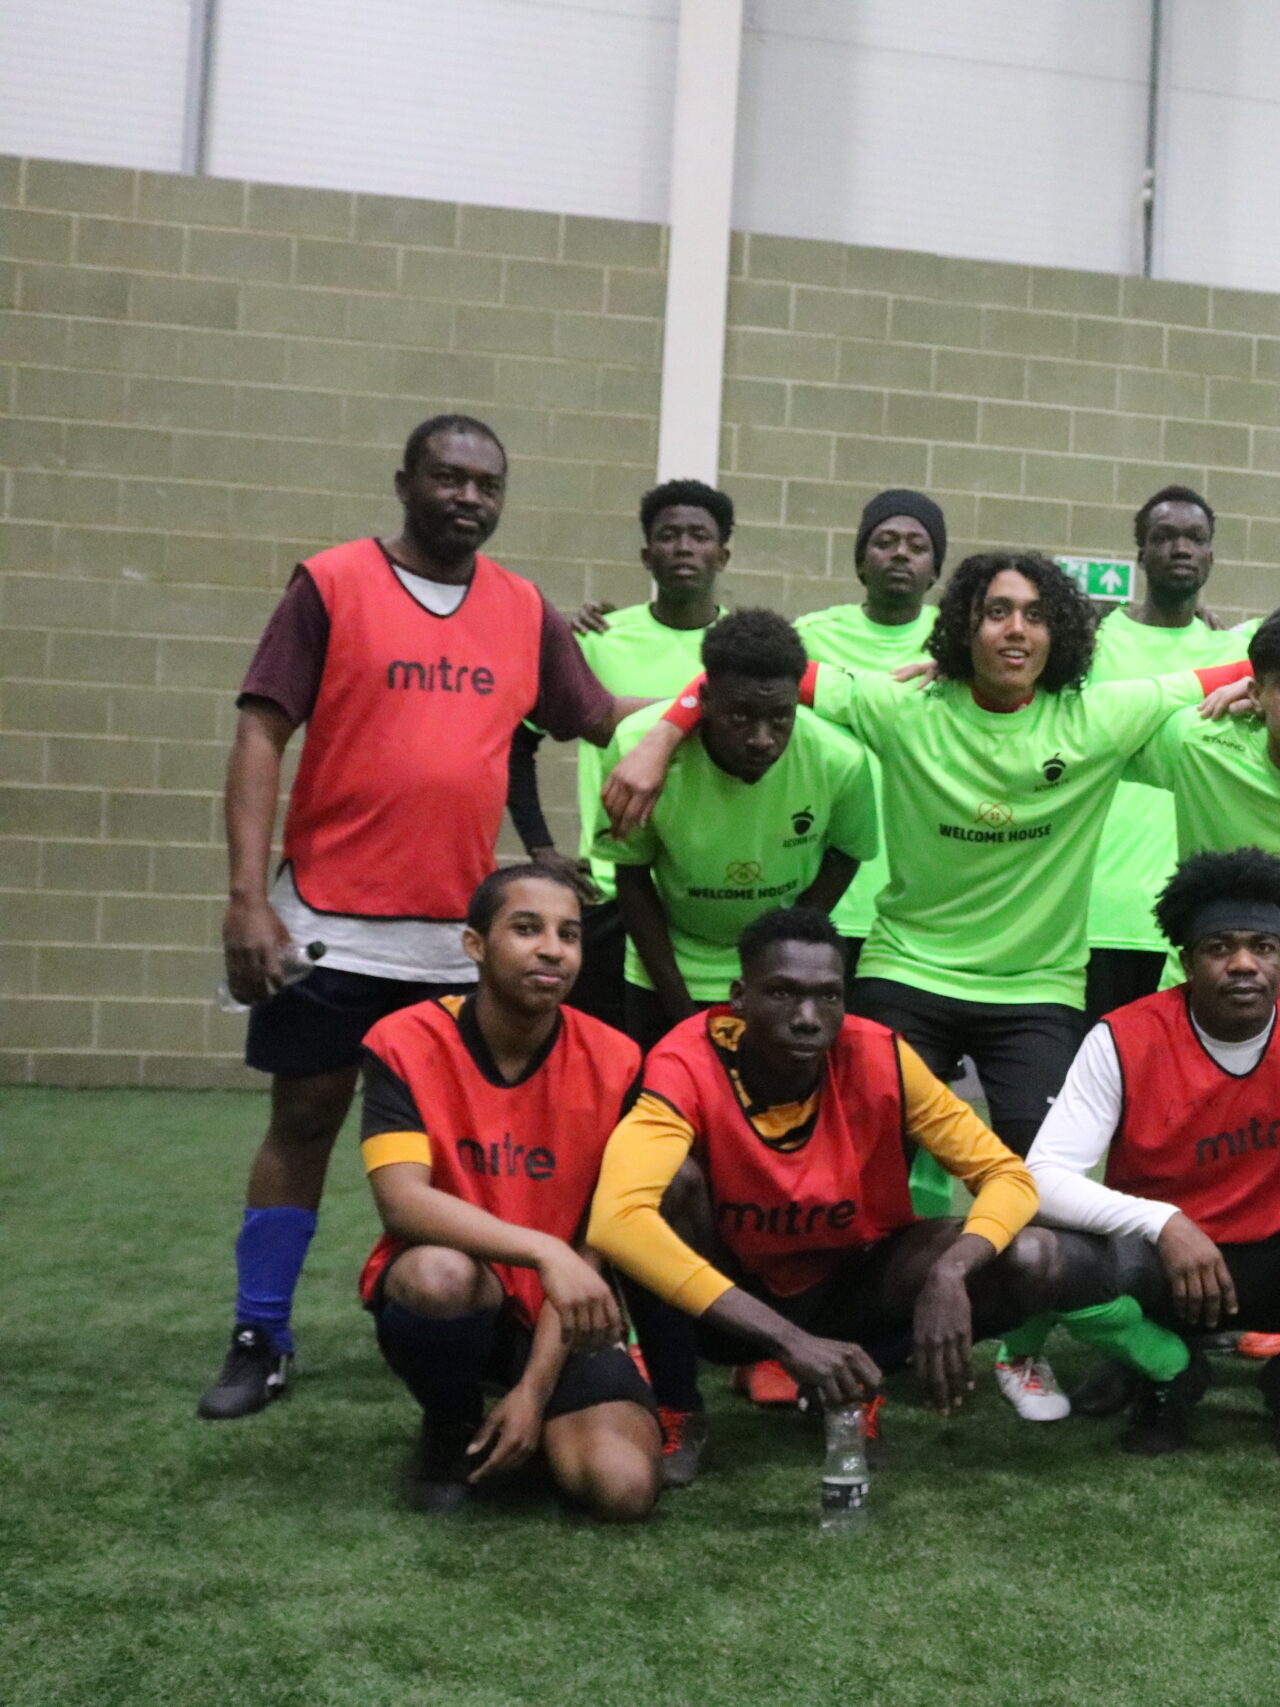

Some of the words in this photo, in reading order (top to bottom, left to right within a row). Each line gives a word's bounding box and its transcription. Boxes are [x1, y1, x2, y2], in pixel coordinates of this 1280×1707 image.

[387, 656, 495, 695] mitre
[940, 824, 1005, 843] WELCOME
[1009, 824, 1052, 842] HOUSE
[687, 887, 755, 900] WELCOME
[718, 1199, 856, 1235] mitre
